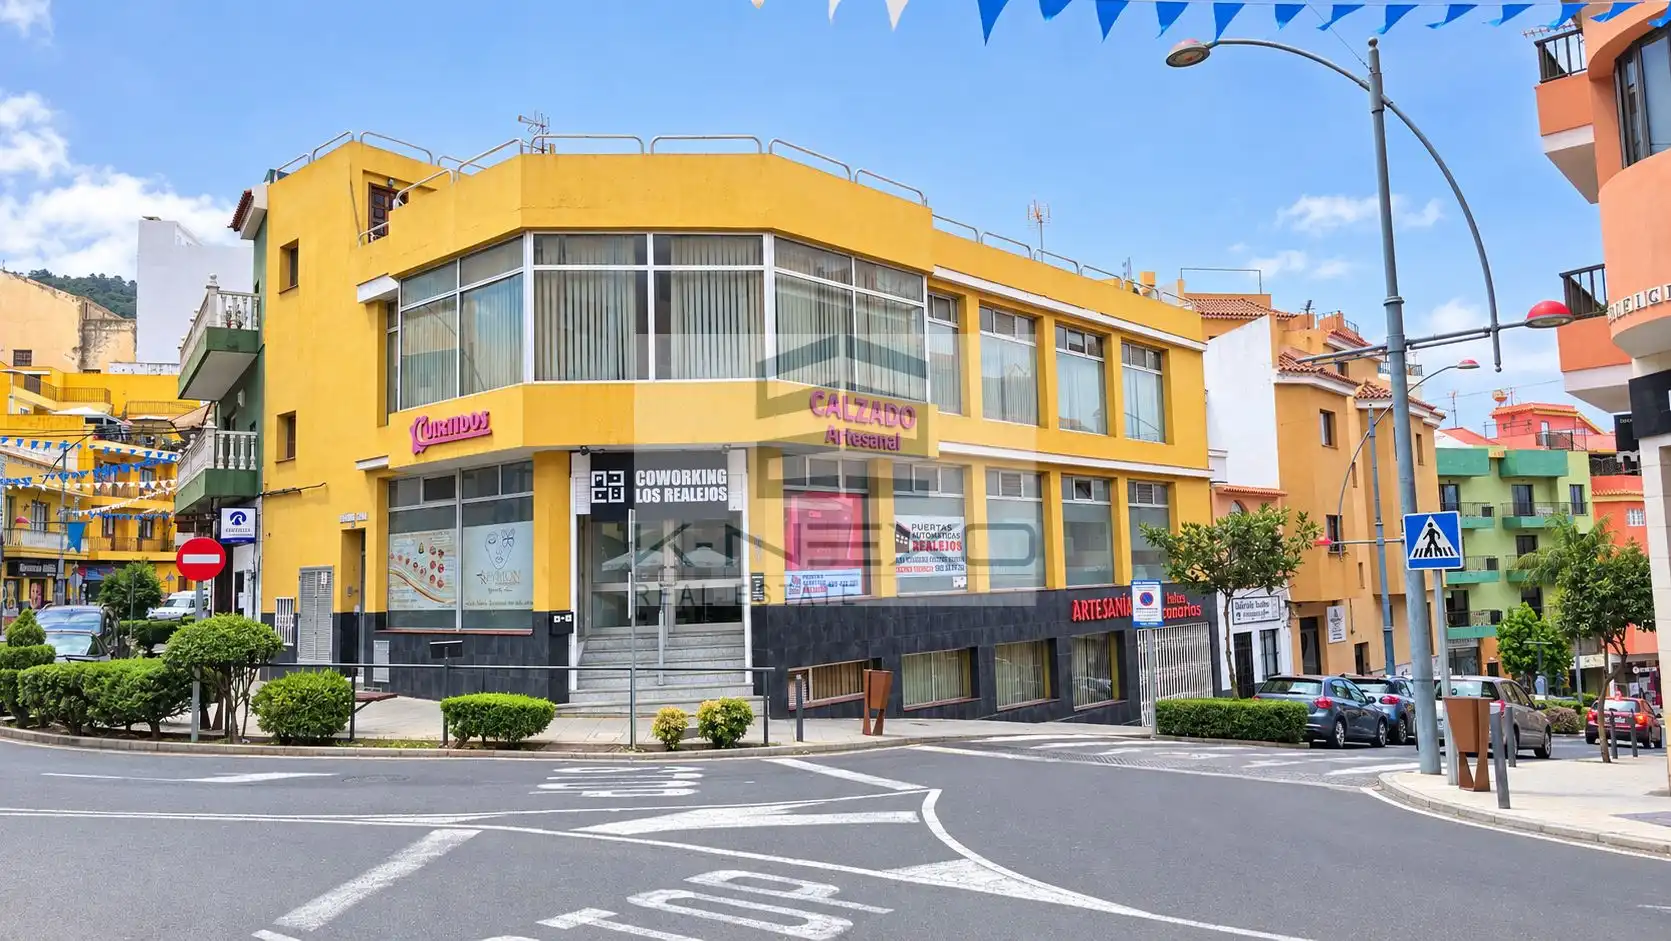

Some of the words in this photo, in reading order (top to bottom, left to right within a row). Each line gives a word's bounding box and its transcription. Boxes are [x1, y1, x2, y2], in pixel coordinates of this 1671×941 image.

[810, 389, 916, 430] CALZADO
[412, 411, 491, 448] CURTIDOS
[825, 424, 900, 452] Artesanal
[635, 469, 727, 486] COWORKING
[635, 488, 661, 503] LOS
[664, 487, 728, 503] REALEJOS
[911, 523, 953, 532] PUERTAS
[912, 540, 963, 552] REALEJOS
[1071, 592, 1133, 622] ARTESANÍA
[479, 869, 894, 941] TOP
